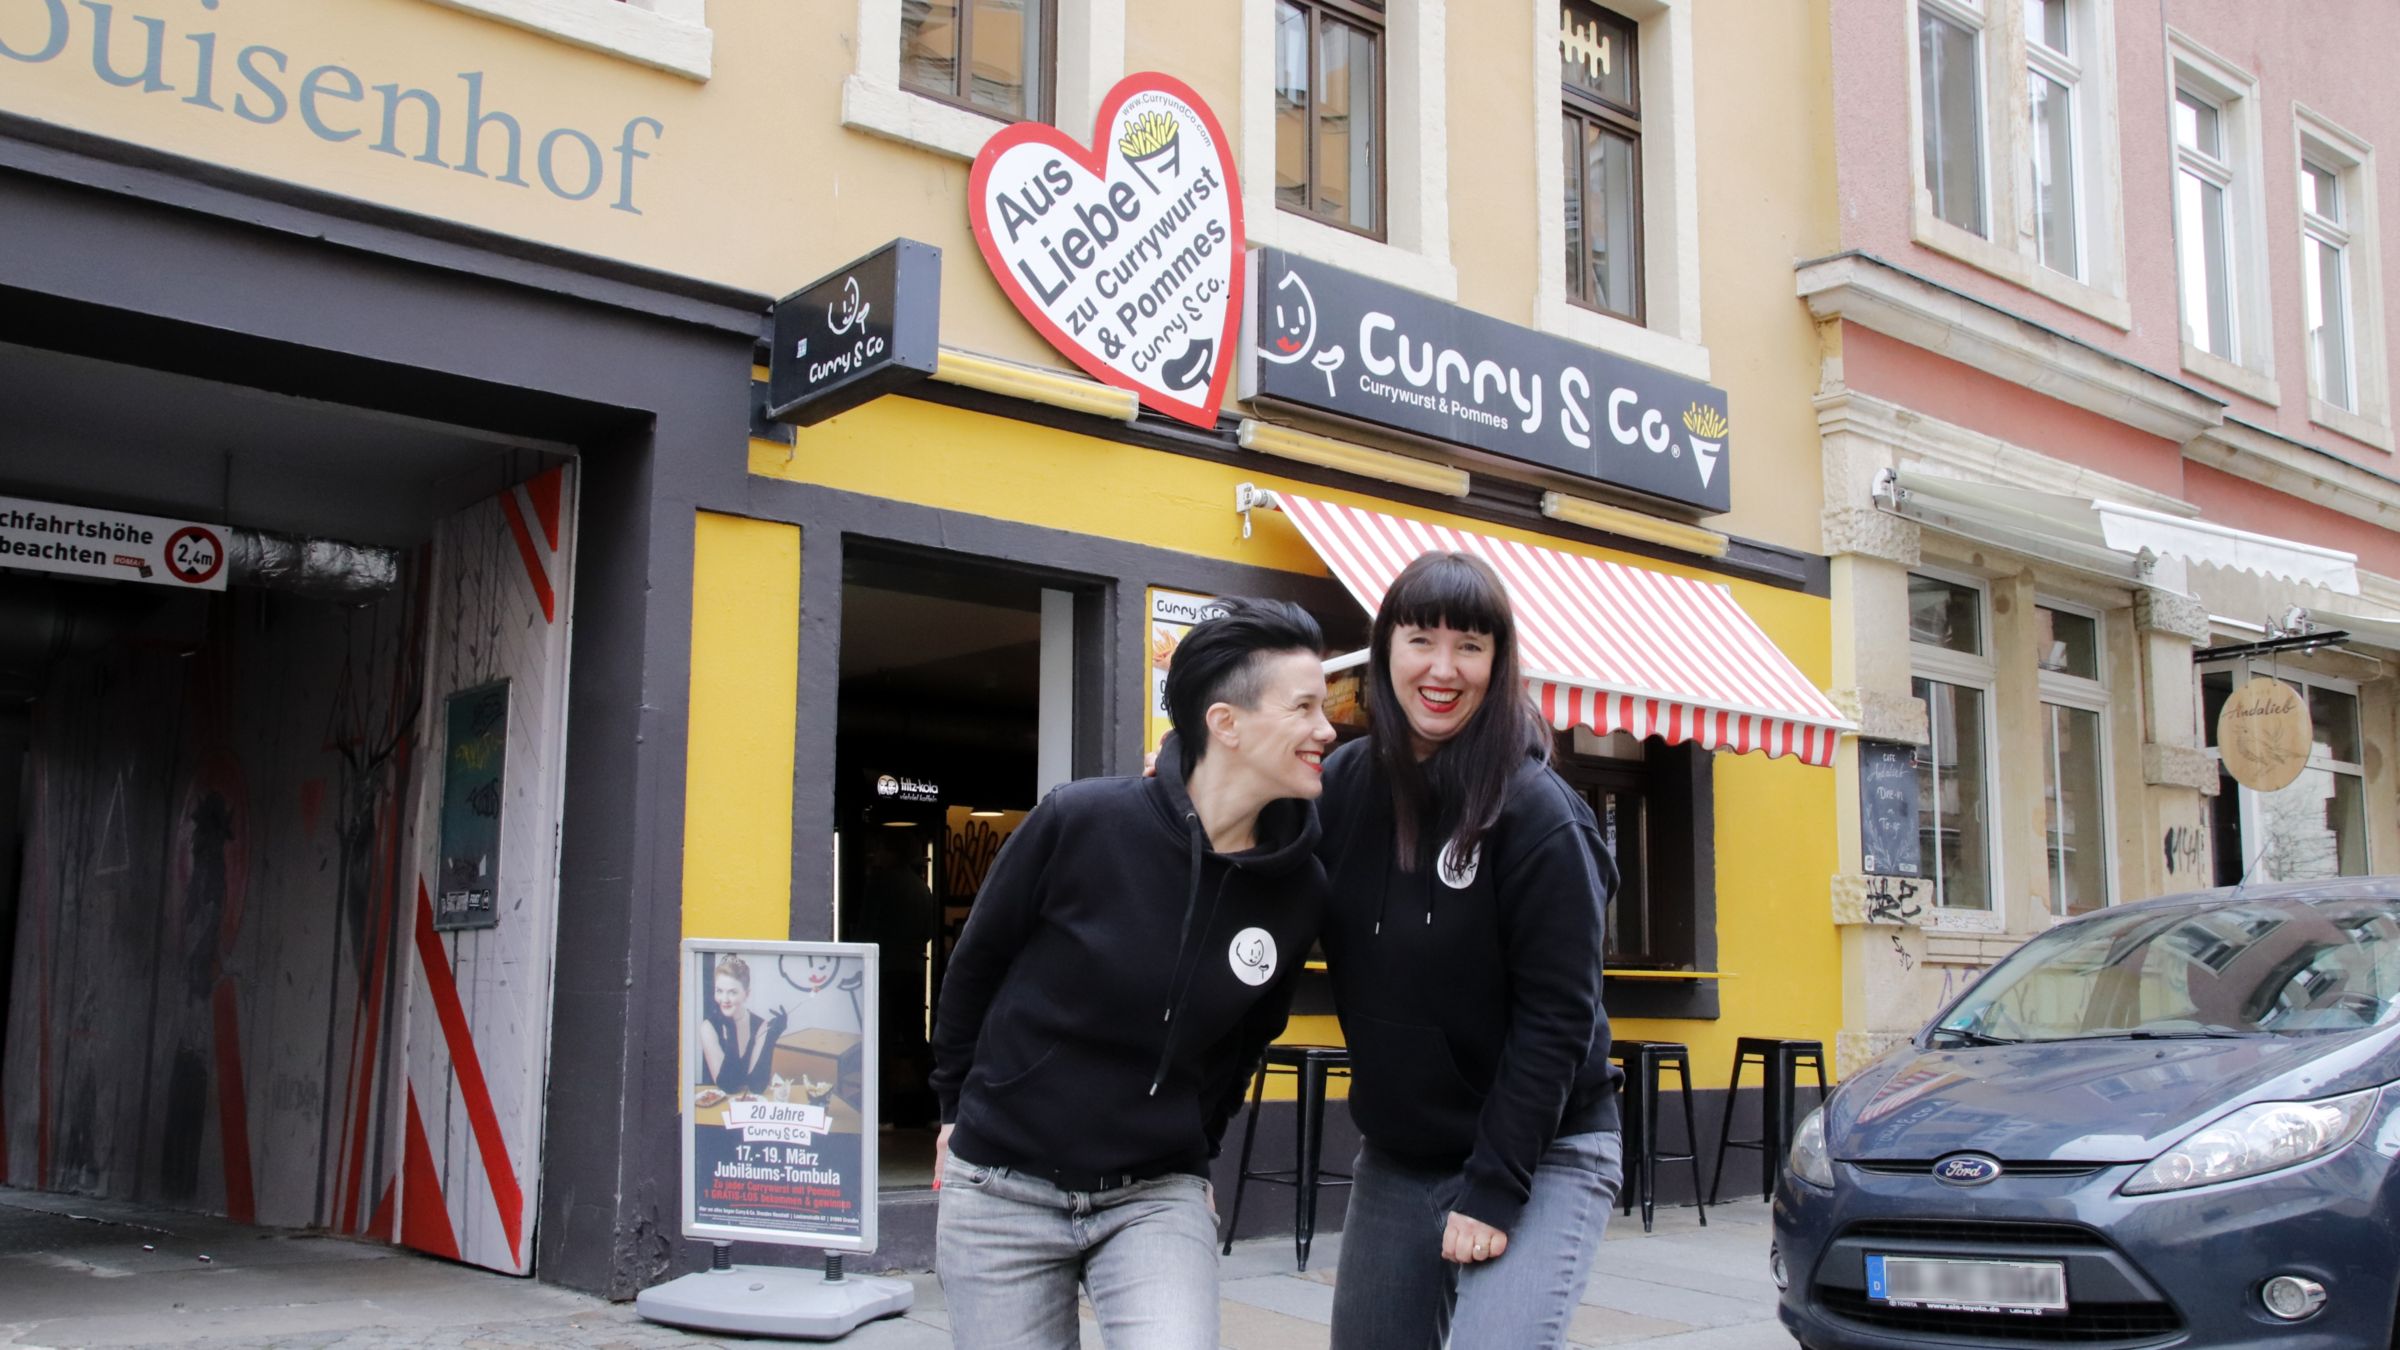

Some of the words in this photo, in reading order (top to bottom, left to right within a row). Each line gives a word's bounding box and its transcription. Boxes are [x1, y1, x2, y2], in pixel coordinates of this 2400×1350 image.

[1121, 93, 1212, 148] www.CurryundCo.com
[1017, 181, 1141, 307] Liebe
[1065, 297, 1099, 337] zu
[1095, 166, 1219, 299] Currywurst
[1098, 327, 1126, 360] &
[1116, 219, 1226, 337] Pommes
[1131, 313, 1188, 373] Curry
[1195, 278, 1225, 304] Co.
[809, 352, 851, 383] Curry
[866, 336, 884, 357] Co
[1360, 311, 1542, 434] Curry
[1360, 375, 1436, 411] Currywurst
[1439, 399, 1449, 414] &
[1451, 400, 1509, 430] Pommes
[0, 535, 107, 566] beachten
[177, 543, 213, 567] 2,4m
[1157, 600, 1197, 620] Curry
[900, 777, 939, 794] fritz-kola
[750, 1105, 766, 1120] 20
[769, 1105, 805, 1122] Jahre
[747, 1125, 782, 1140] Curry
[786, 1147, 819, 1166] März
[1945, 1160, 1982, 1177] Ford
[714, 1161, 841, 1185] Jubiläums-Tombula
[1873, 1281, 1881, 1291] D
